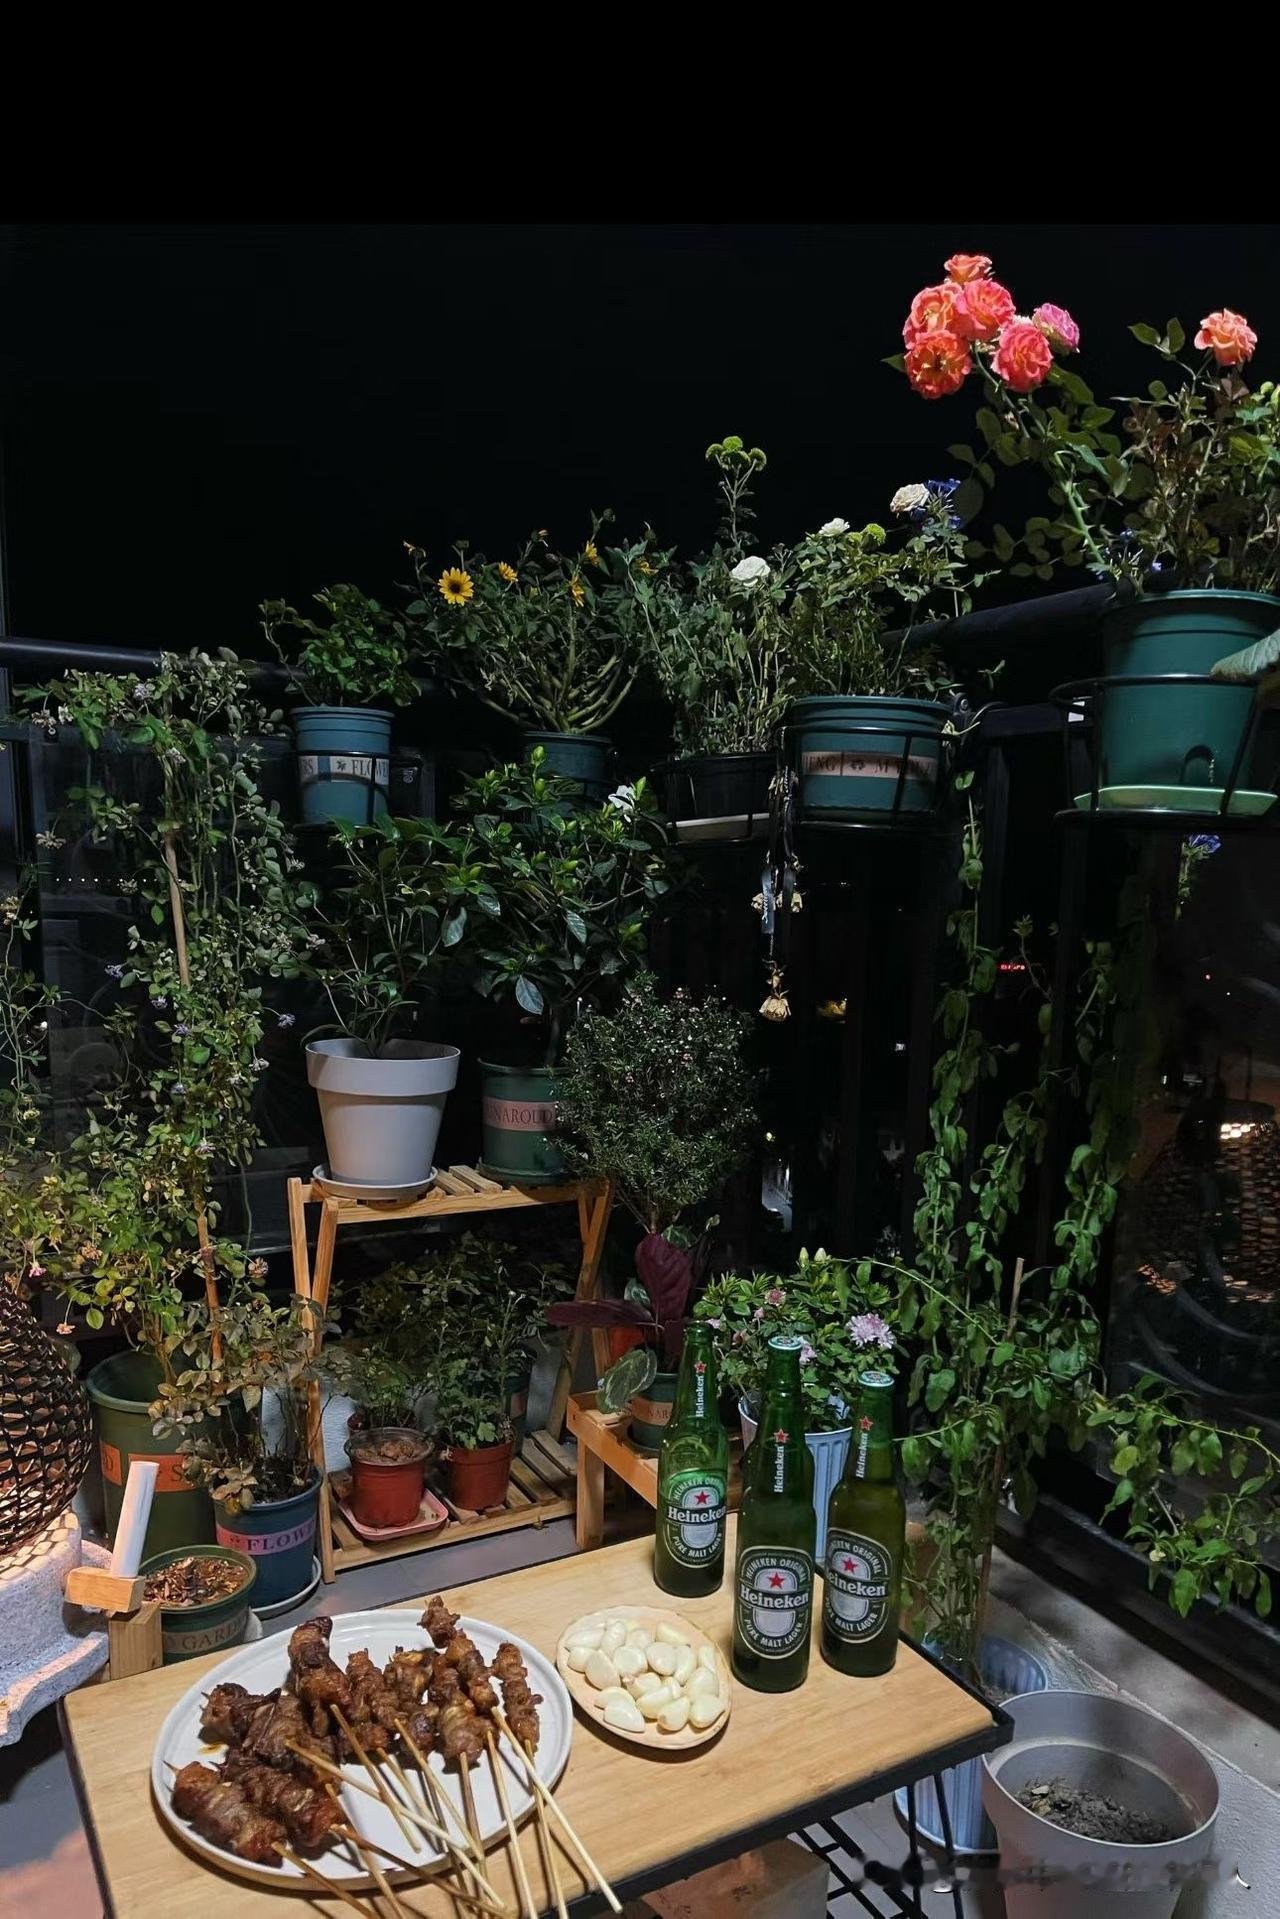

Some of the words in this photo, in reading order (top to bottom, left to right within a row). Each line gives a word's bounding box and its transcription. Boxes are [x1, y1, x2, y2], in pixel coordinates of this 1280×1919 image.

[695, 1374, 705, 1418] Heineken
[773, 1445, 785, 1494] Heineken
[855, 1432, 869, 1480] Heineken
[667, 1505, 727, 1523] Heineken
[672, 1535, 688, 1555] PURE
[688, 1550, 707, 1558] MALT
[852, 1545, 882, 1575] ORIGINAL
[745, 1557, 777, 1580] HEINEKEN
[780, 1559, 807, 1583] ORIGINAL
[826, 1569, 886, 1597] eineken
[740, 1585, 809, 1609] Heineken
[744, 1619, 760, 1641] PURE
[760, 1637, 783, 1649] MALT
[784, 1621, 804, 1645] LAGER
[835, 1617, 854, 1632] MALT
[856, 1612, 878, 1632] LAGER
